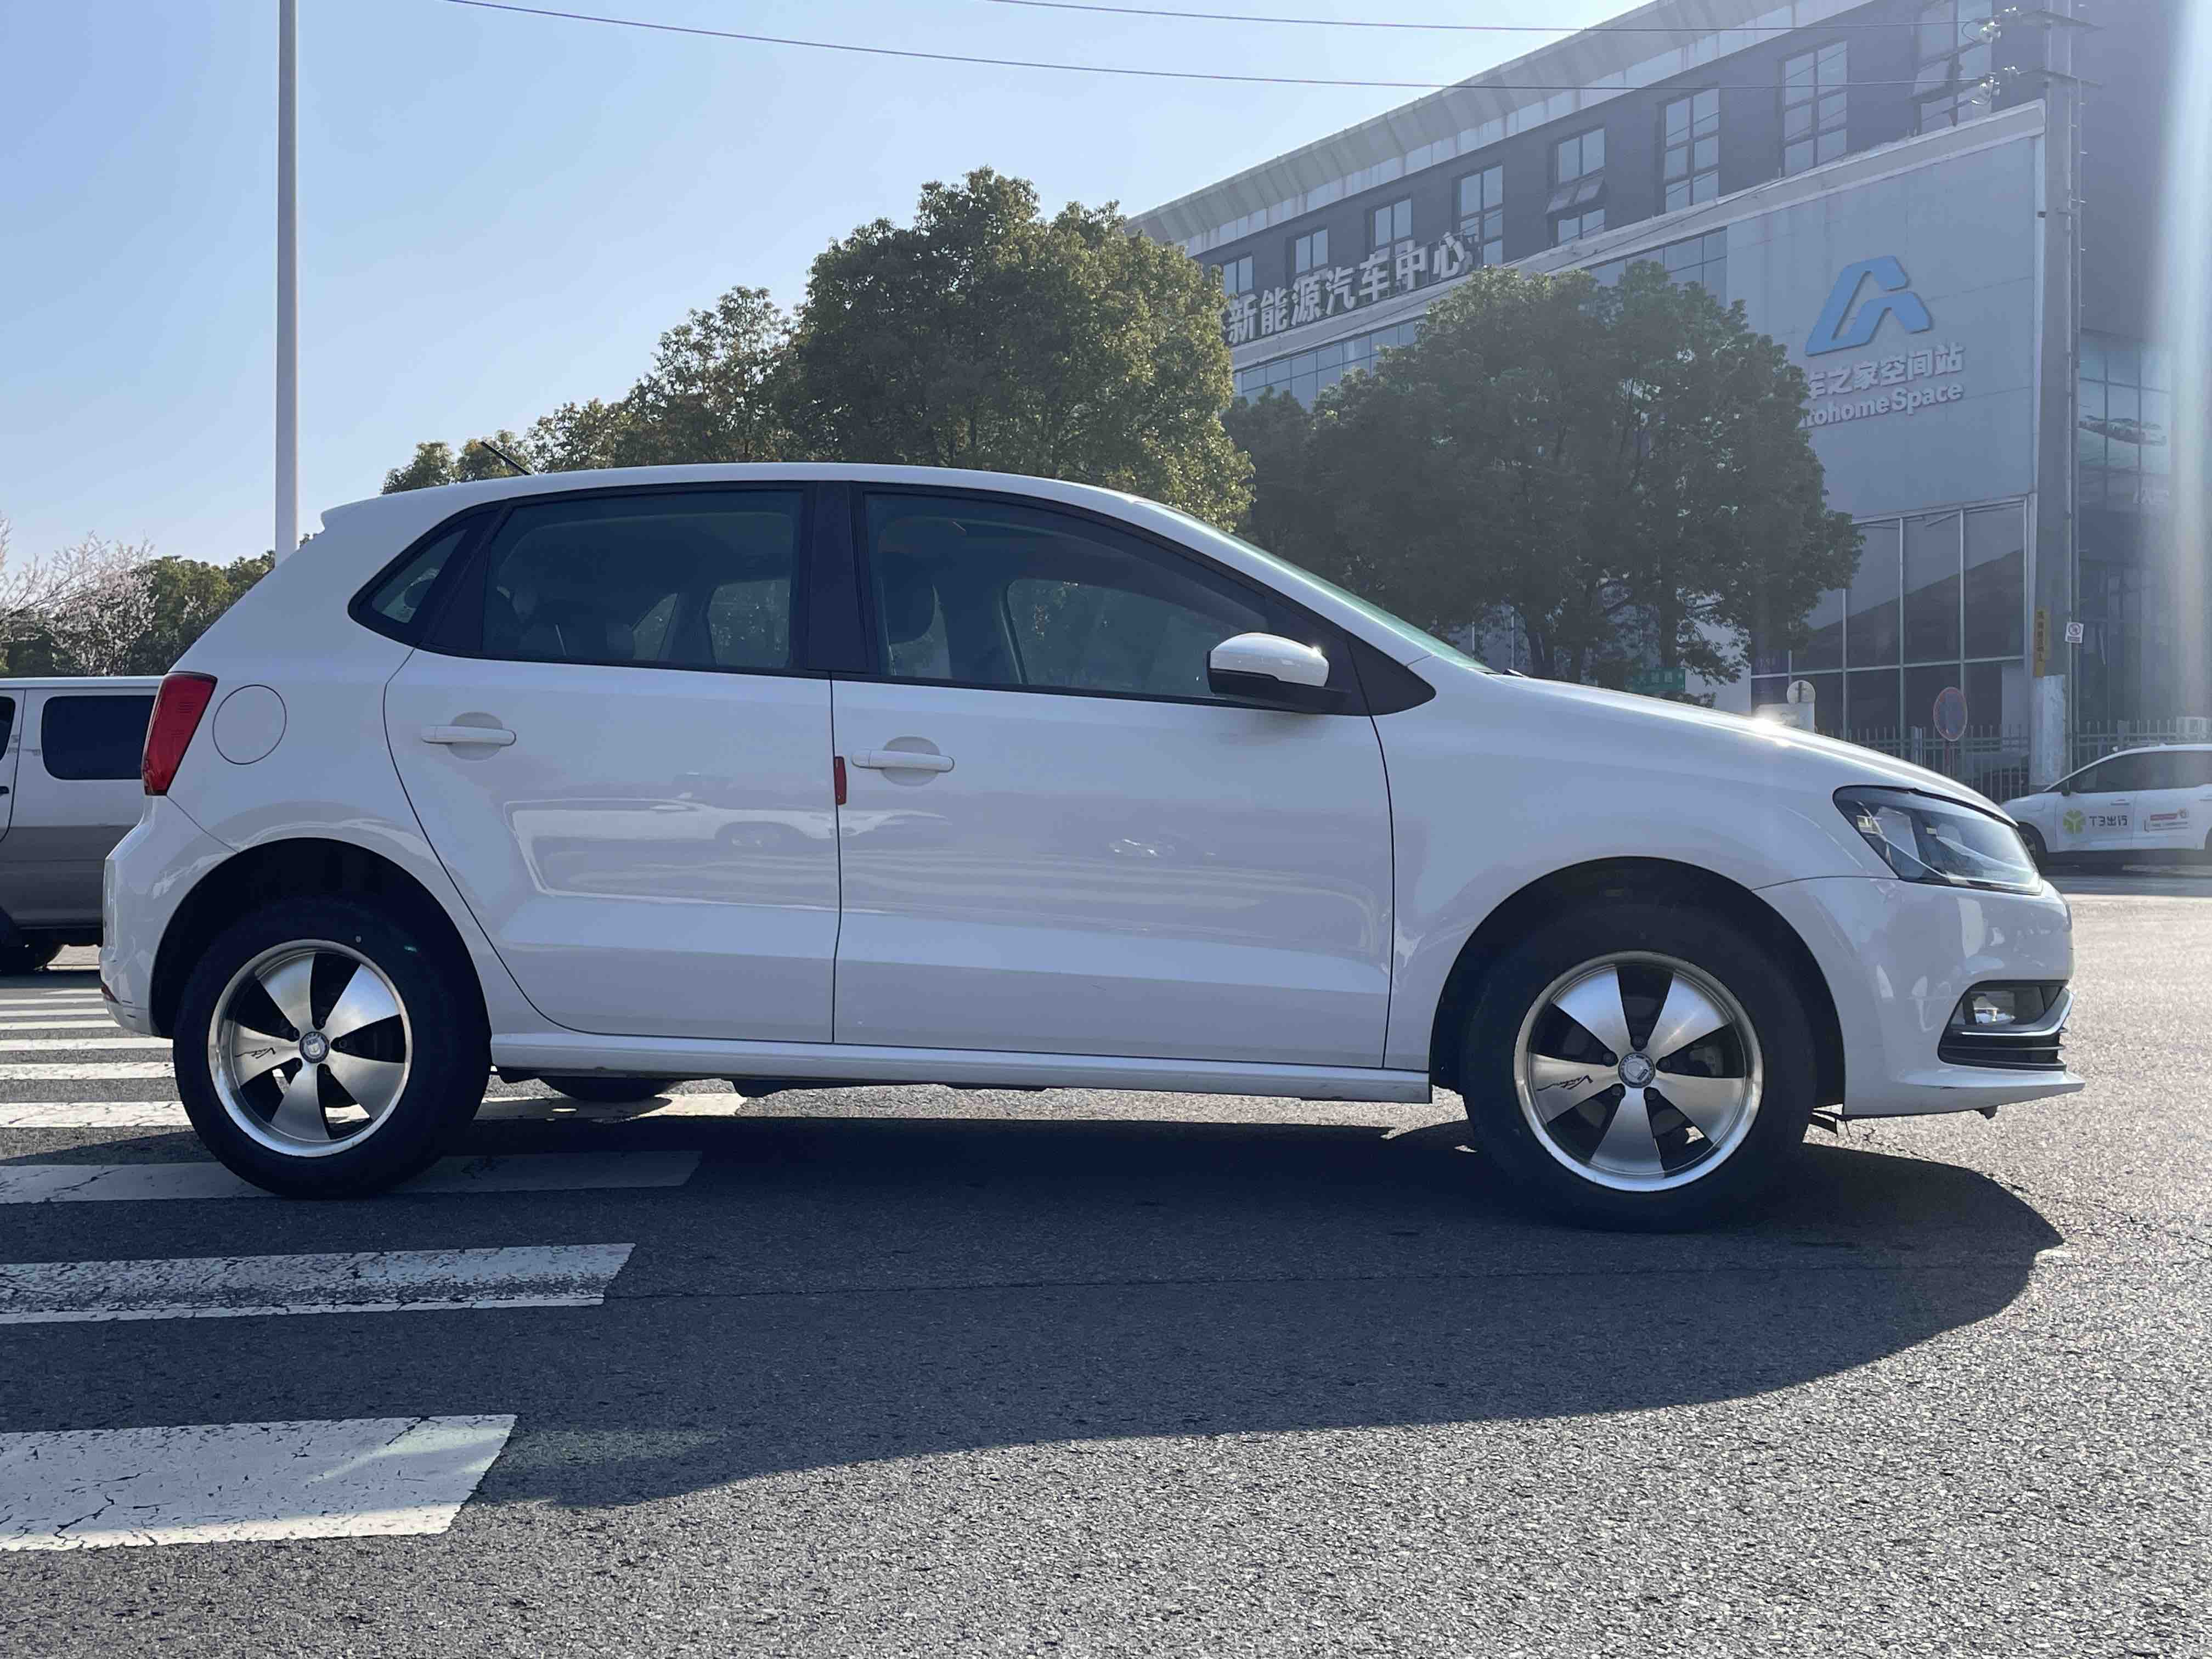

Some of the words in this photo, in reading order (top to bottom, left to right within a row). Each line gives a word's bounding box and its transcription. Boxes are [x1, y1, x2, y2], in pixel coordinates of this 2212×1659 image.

[1228, 232, 1465, 343] 新能源汽车中心
